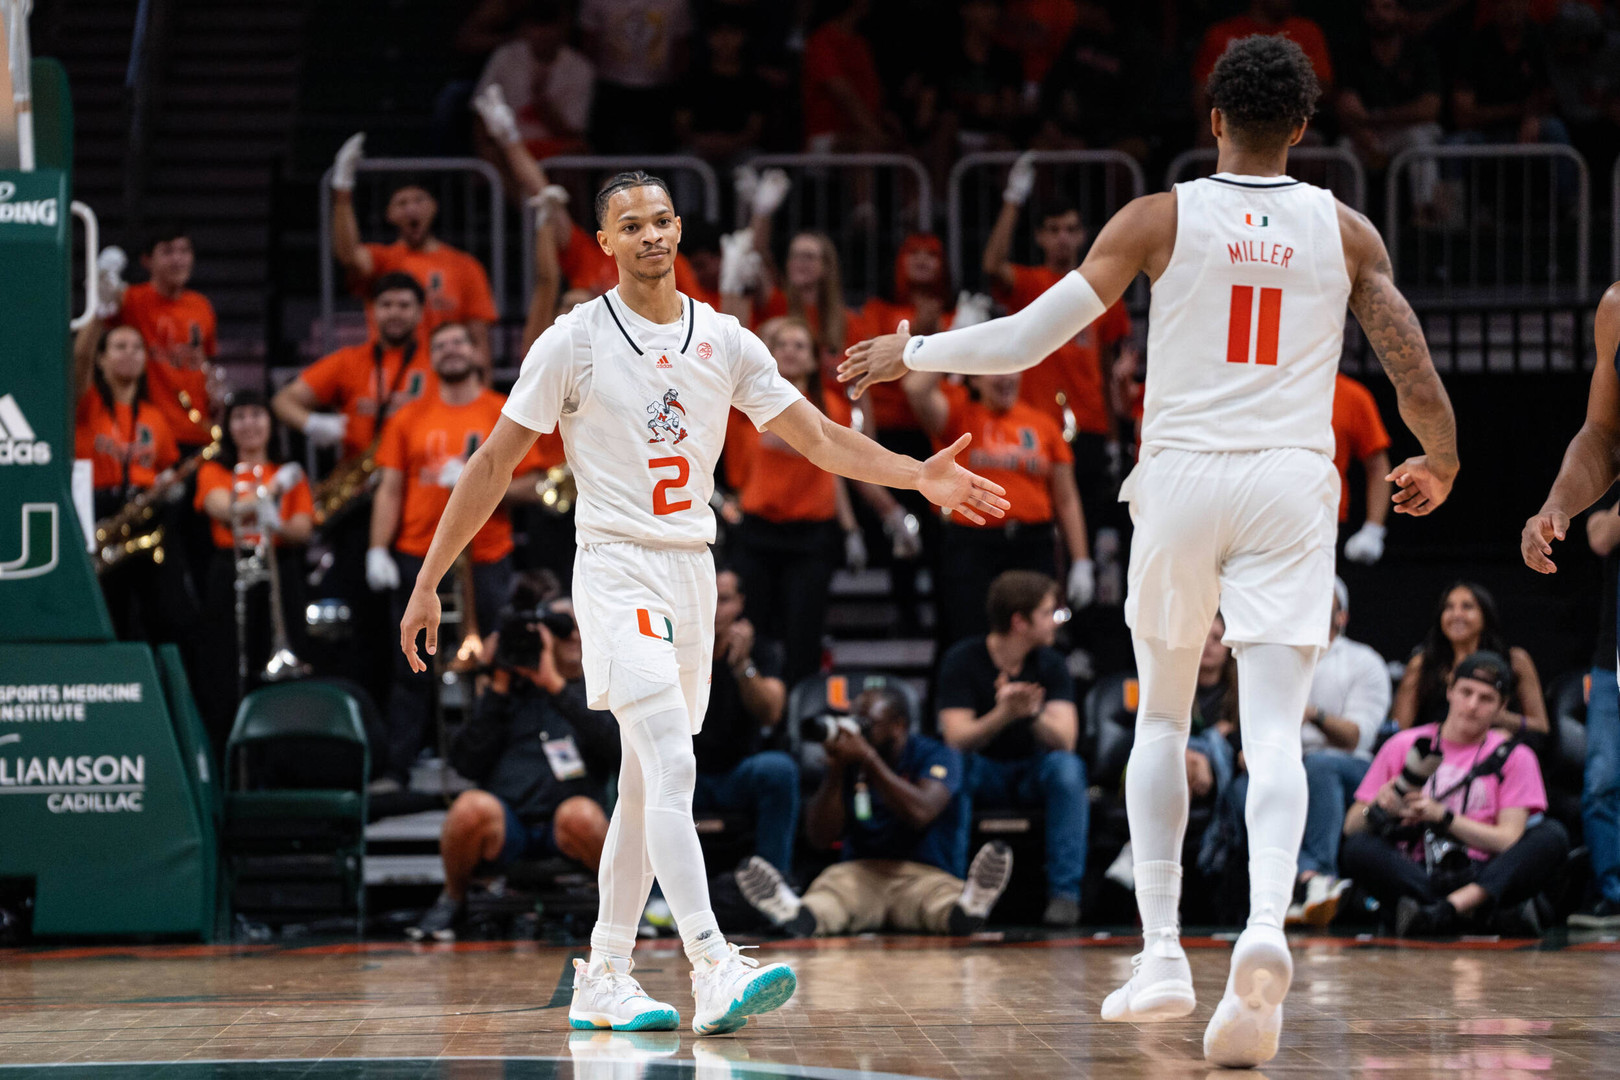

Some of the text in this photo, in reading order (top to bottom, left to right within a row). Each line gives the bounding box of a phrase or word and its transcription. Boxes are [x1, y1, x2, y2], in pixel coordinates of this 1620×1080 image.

[1245, 213, 1268, 228] U
[1227, 240, 1294, 269] MILLER
[1226, 284, 1283, 366] 11
[648, 455, 692, 516] 2
[636, 608, 674, 644] U
[62, 683, 142, 702] MEDICINE
[0, 703, 85, 721] NSTITUTE
[47, 792, 143, 813] CADILLAC
